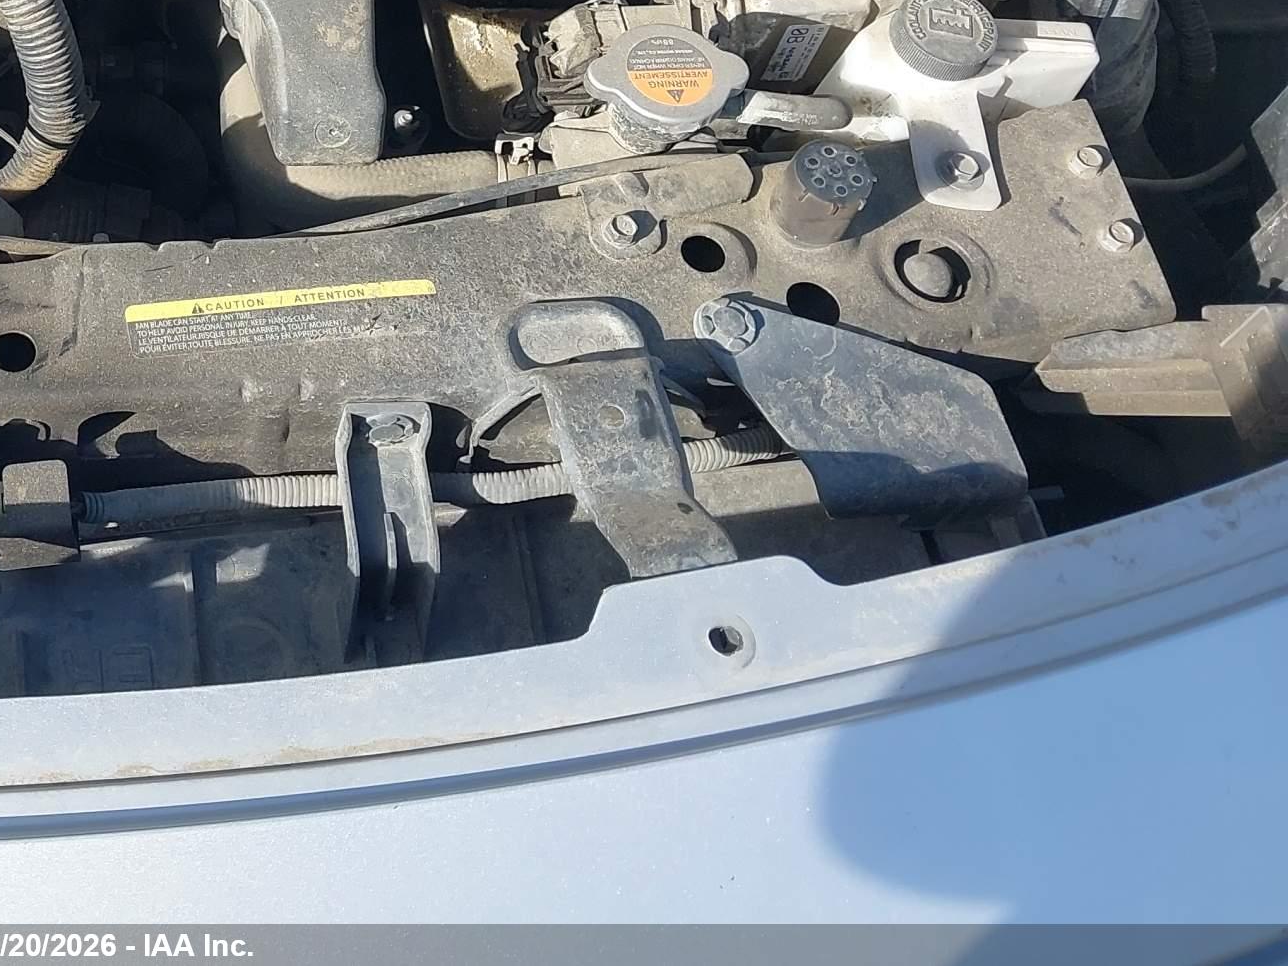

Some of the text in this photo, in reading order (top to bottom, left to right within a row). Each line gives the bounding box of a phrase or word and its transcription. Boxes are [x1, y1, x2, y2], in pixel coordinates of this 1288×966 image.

[633, 71, 708, 80] AVERTISSEMENT
[647, 80, 700, 89] WARNING
[206, 298, 265, 312] CAUTION
[294, 288, 365, 303] ATTENTION
[137, 329, 148, 338] TO
[149, 327, 165, 337] HELP
[166, 325, 188, 335] AVOID
[189, 322, 224, 333] PERSONAL
[250, 318, 267, 327] KEEP
[268, 315, 293, 325] HANDS
[150, 320, 172, 329] BLADE
[173, 318, 188, 327] CAN
[187, 315, 209, 325] START
[210, 314, 219, 322] AT
[220, 313, 235, 321] ANY
[138, 337, 148, 346] LE
[148, 333, 197, 345] VENTILATEUR
[197, 331, 226, 341] RISQUE
[227, 329, 236, 337] DE
[288, 323, 310, 332] TOUT
[139, 344, 162, 354] POUR
[188, 340, 213, 350] TOUTE
[253, 334, 265, 342] NE
[265, 332, 280, 342] PAS
[281, 331, 292, 340] EN
